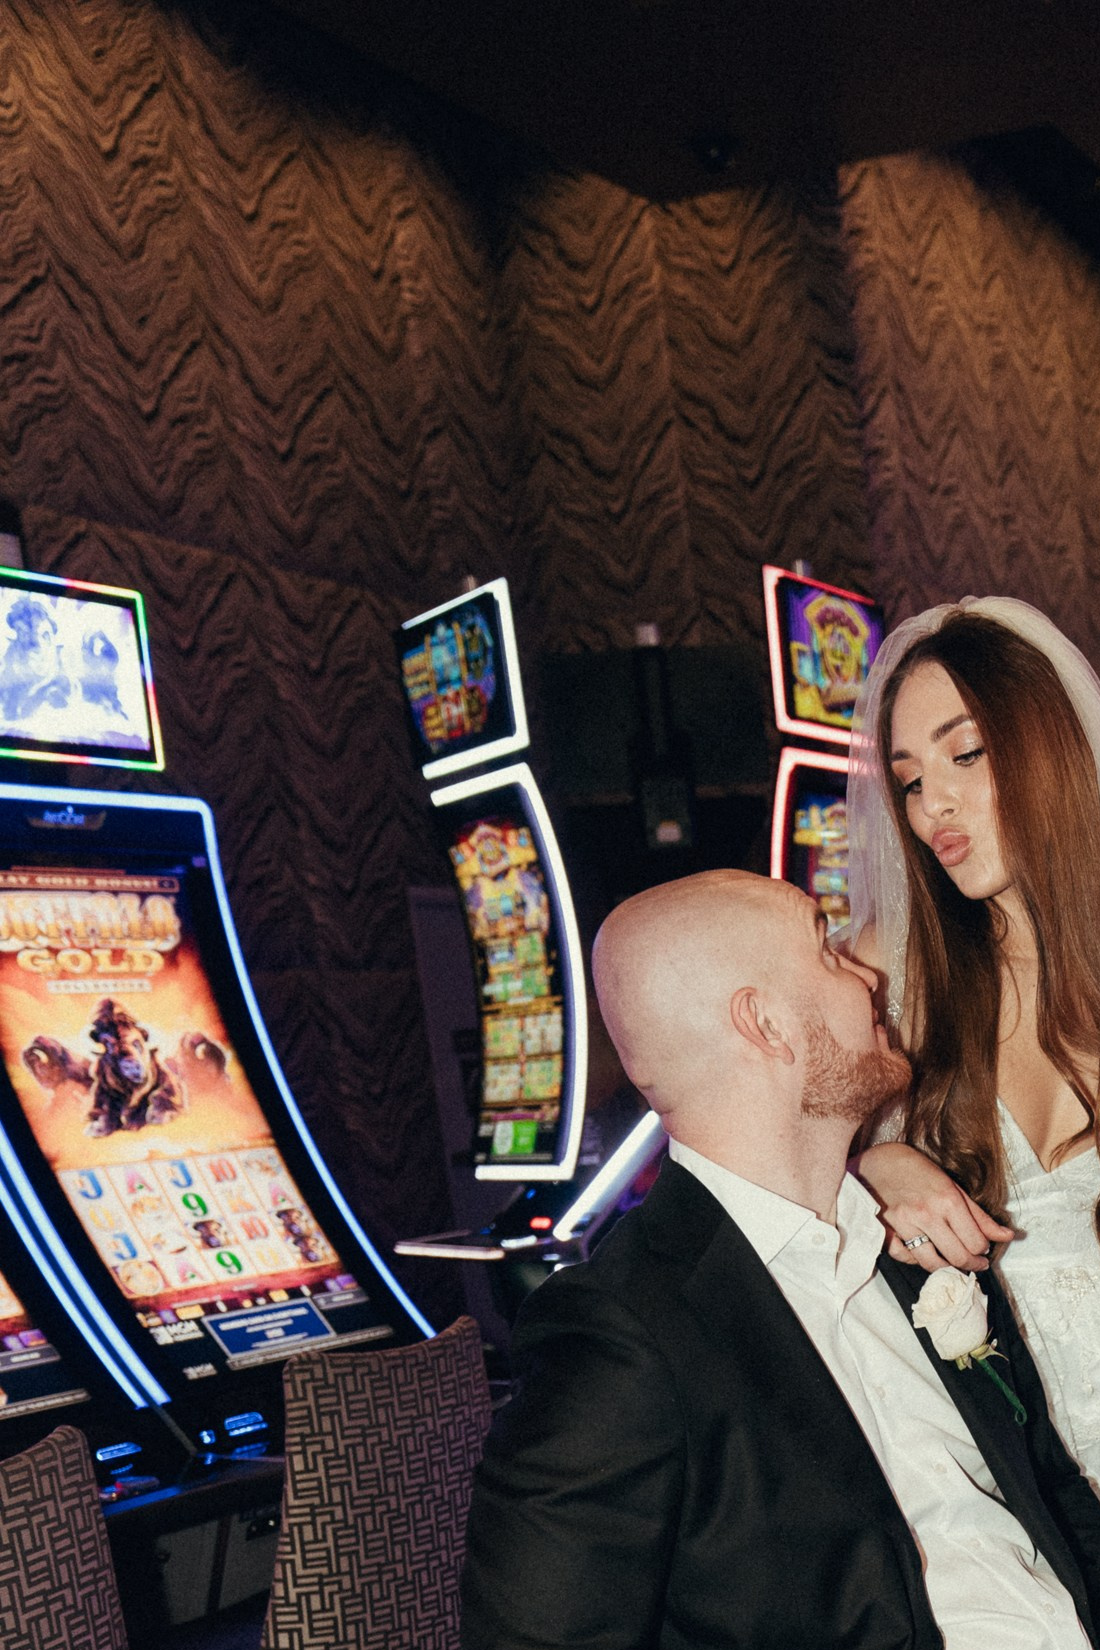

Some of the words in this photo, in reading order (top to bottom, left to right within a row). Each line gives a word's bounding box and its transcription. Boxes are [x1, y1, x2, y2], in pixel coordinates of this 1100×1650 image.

[16, 948, 165, 976] GOLD
[76, 1169, 104, 1200] J
[167, 1160, 193, 1188] J
[181, 1192, 209, 1217] 9
[215, 1250, 243, 1275] 9
